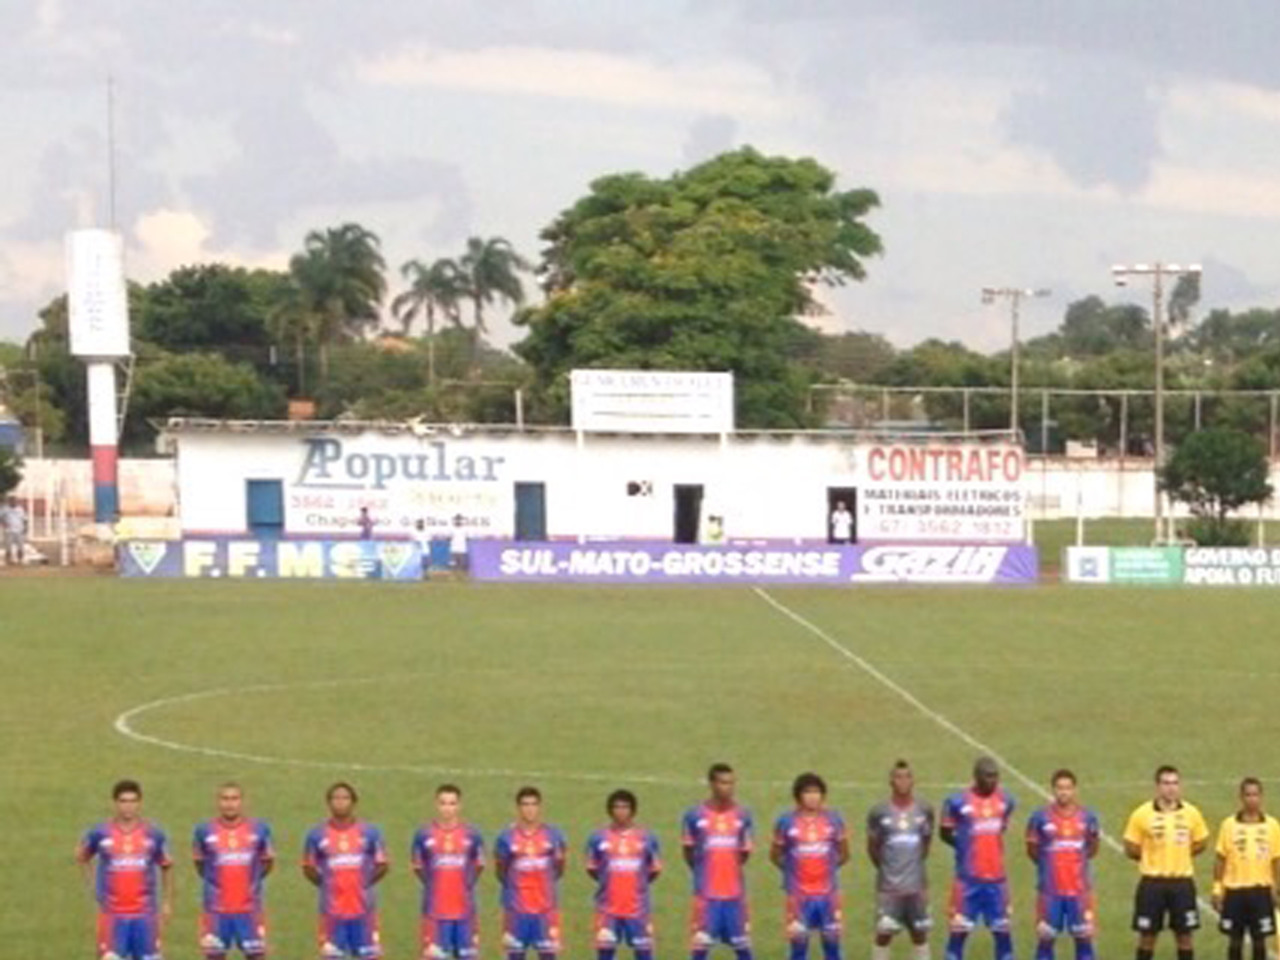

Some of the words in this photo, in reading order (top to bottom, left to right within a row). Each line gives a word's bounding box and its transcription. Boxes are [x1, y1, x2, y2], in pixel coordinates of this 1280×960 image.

[867, 446, 1021, 482] CONTRAFO
[1184, 549, 1268, 566] GOVERNO
[1184, 567, 1235, 584] APOIA
[1238, 567, 1253, 584] O
